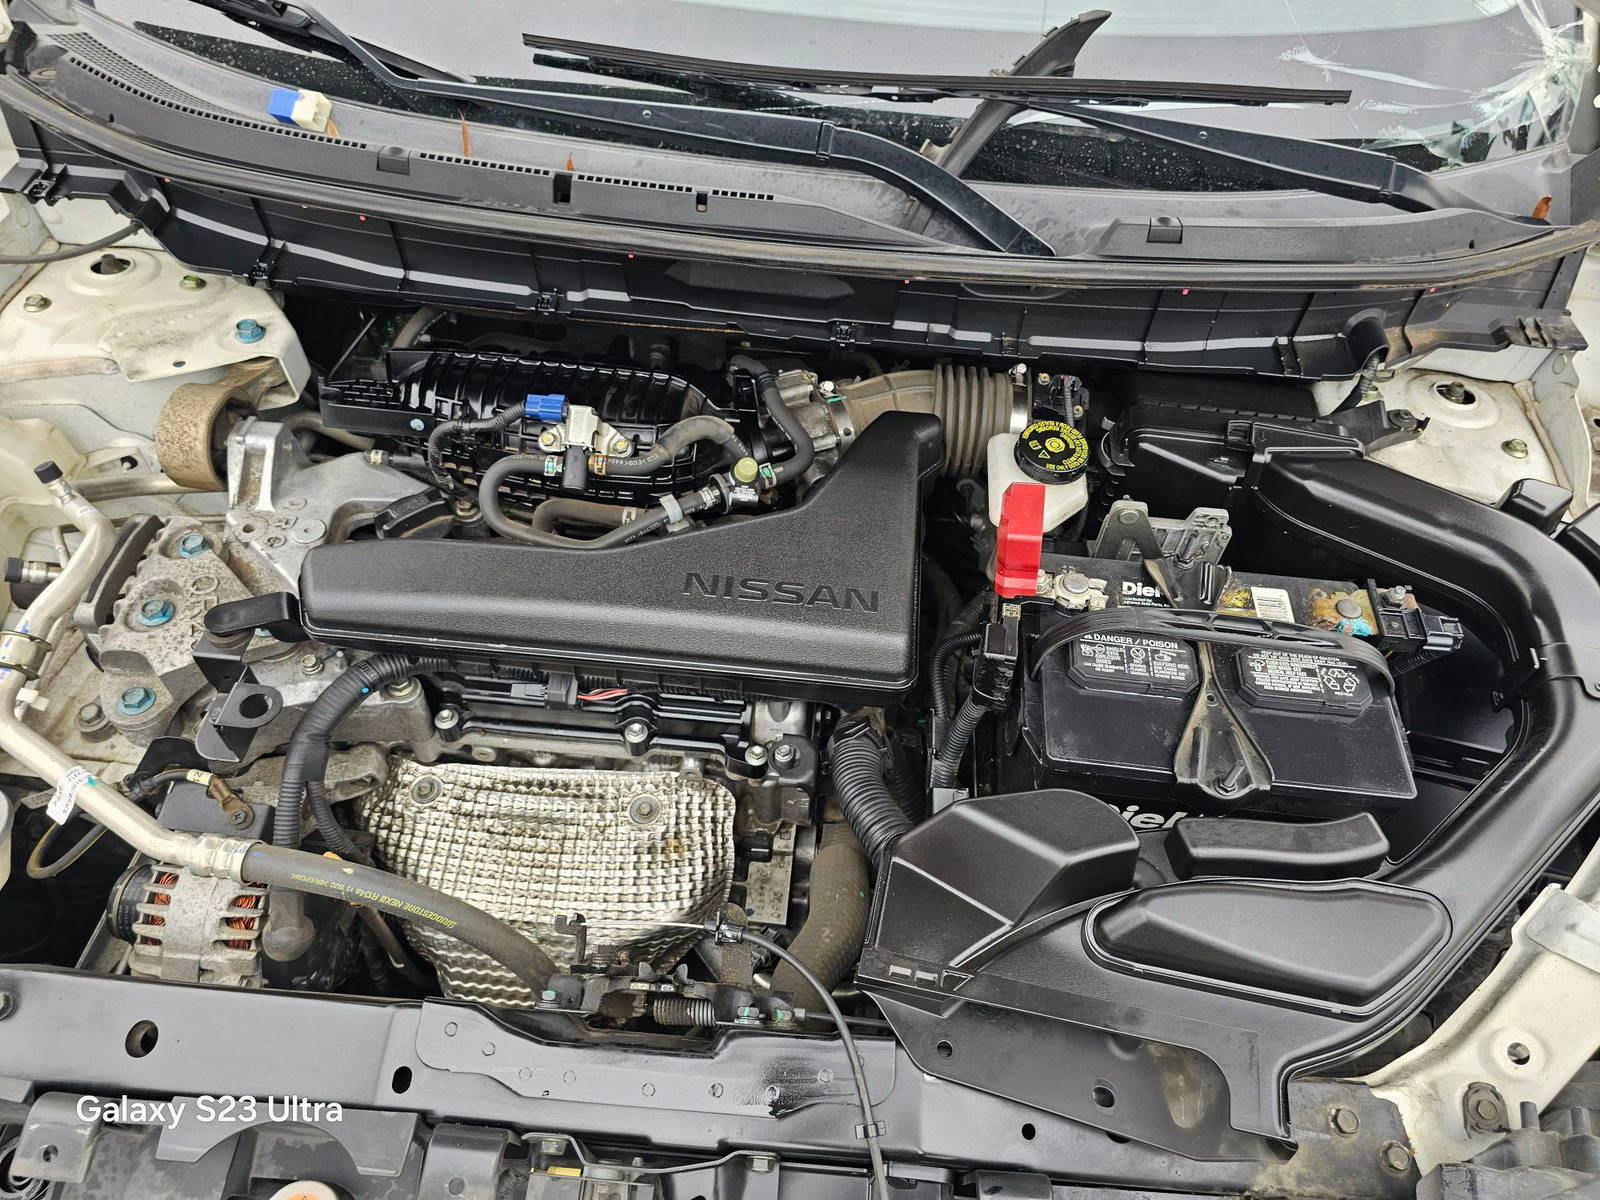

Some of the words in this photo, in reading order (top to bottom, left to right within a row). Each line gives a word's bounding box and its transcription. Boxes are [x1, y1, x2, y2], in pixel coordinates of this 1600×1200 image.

[683, 573, 879, 614] NISSAN
[1094, 634, 1132, 644] DANGER
[1142, 640, 1178, 649] POISON
[402, 902, 458, 929] BRIDGESTONE
